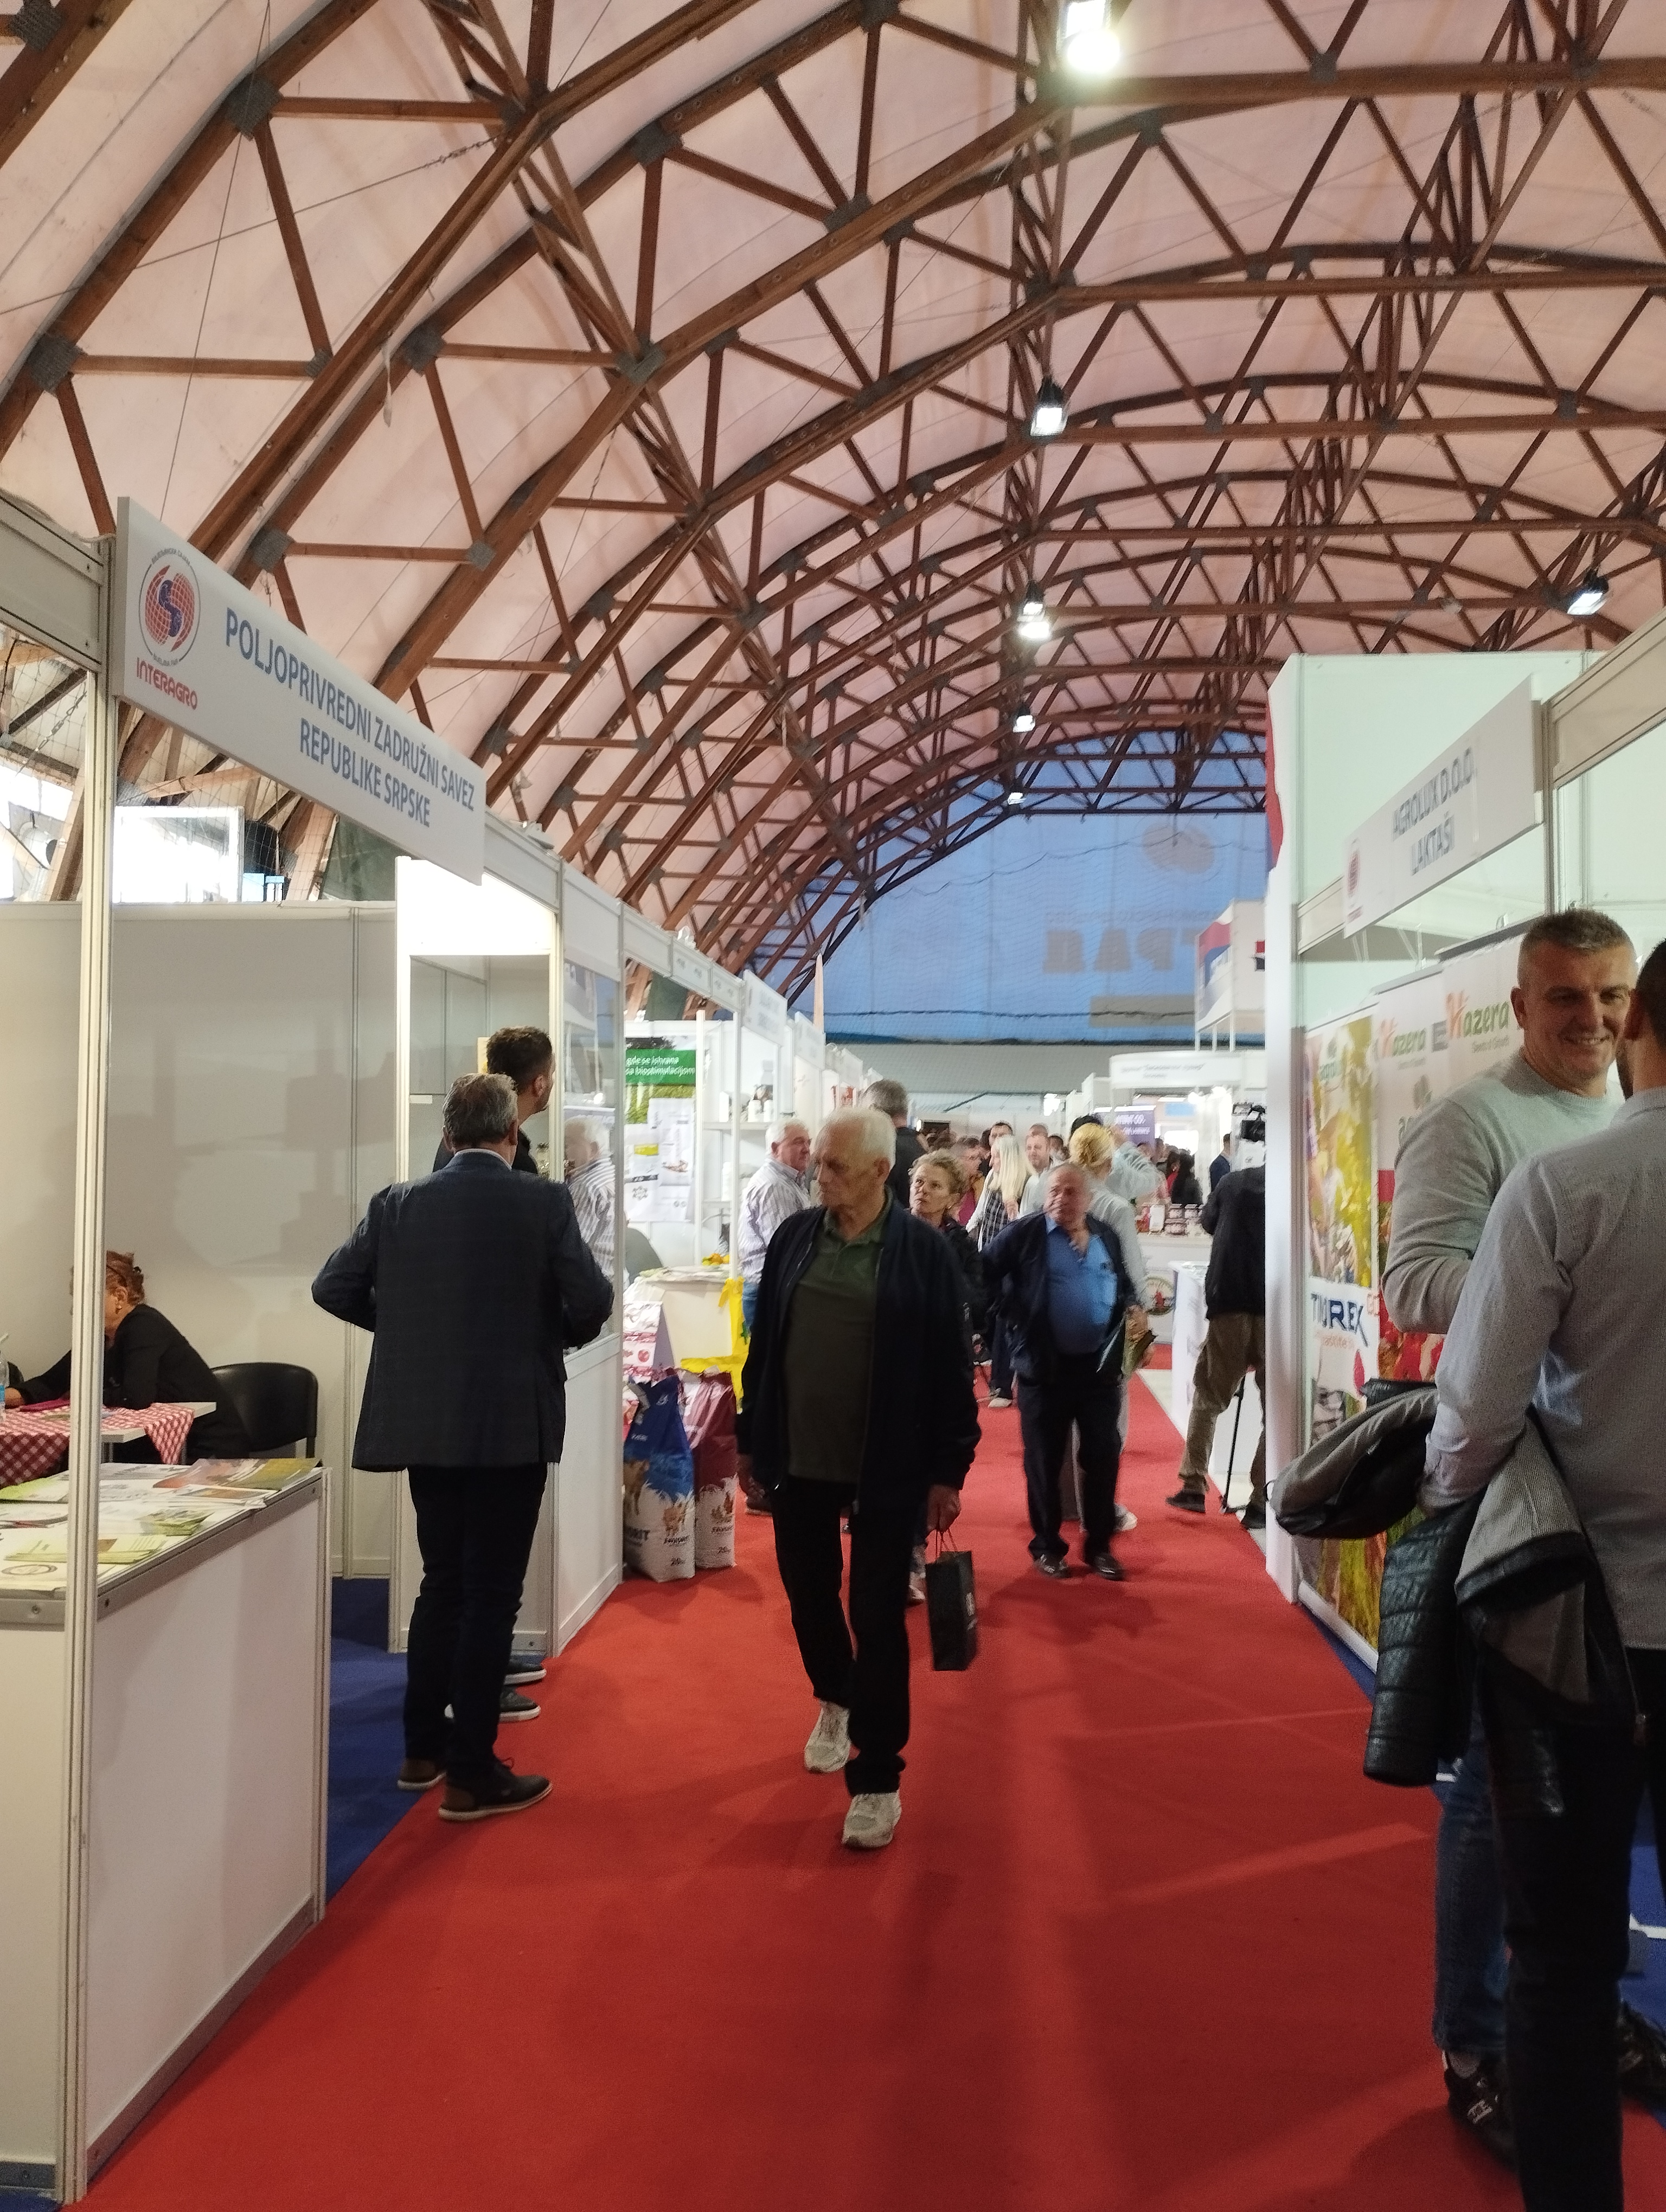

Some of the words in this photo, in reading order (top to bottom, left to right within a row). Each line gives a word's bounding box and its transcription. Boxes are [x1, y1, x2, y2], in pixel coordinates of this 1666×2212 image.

[137, 657, 197, 710] INTERAGRO
[226, 607, 371, 743] POLJOPRIVREDNI
[374, 716, 439, 789] ZADRUŽNI
[440, 765, 475, 812] SAVEZ
[300, 718, 381, 799] REPUBLIKE
[385, 773, 430, 827] SRPSKE
[1412, 812, 1455, 876] LAKTAŠI
[651, 1056, 679, 1065] ishrana
[1311, 1293, 1368, 1348] TUREX
